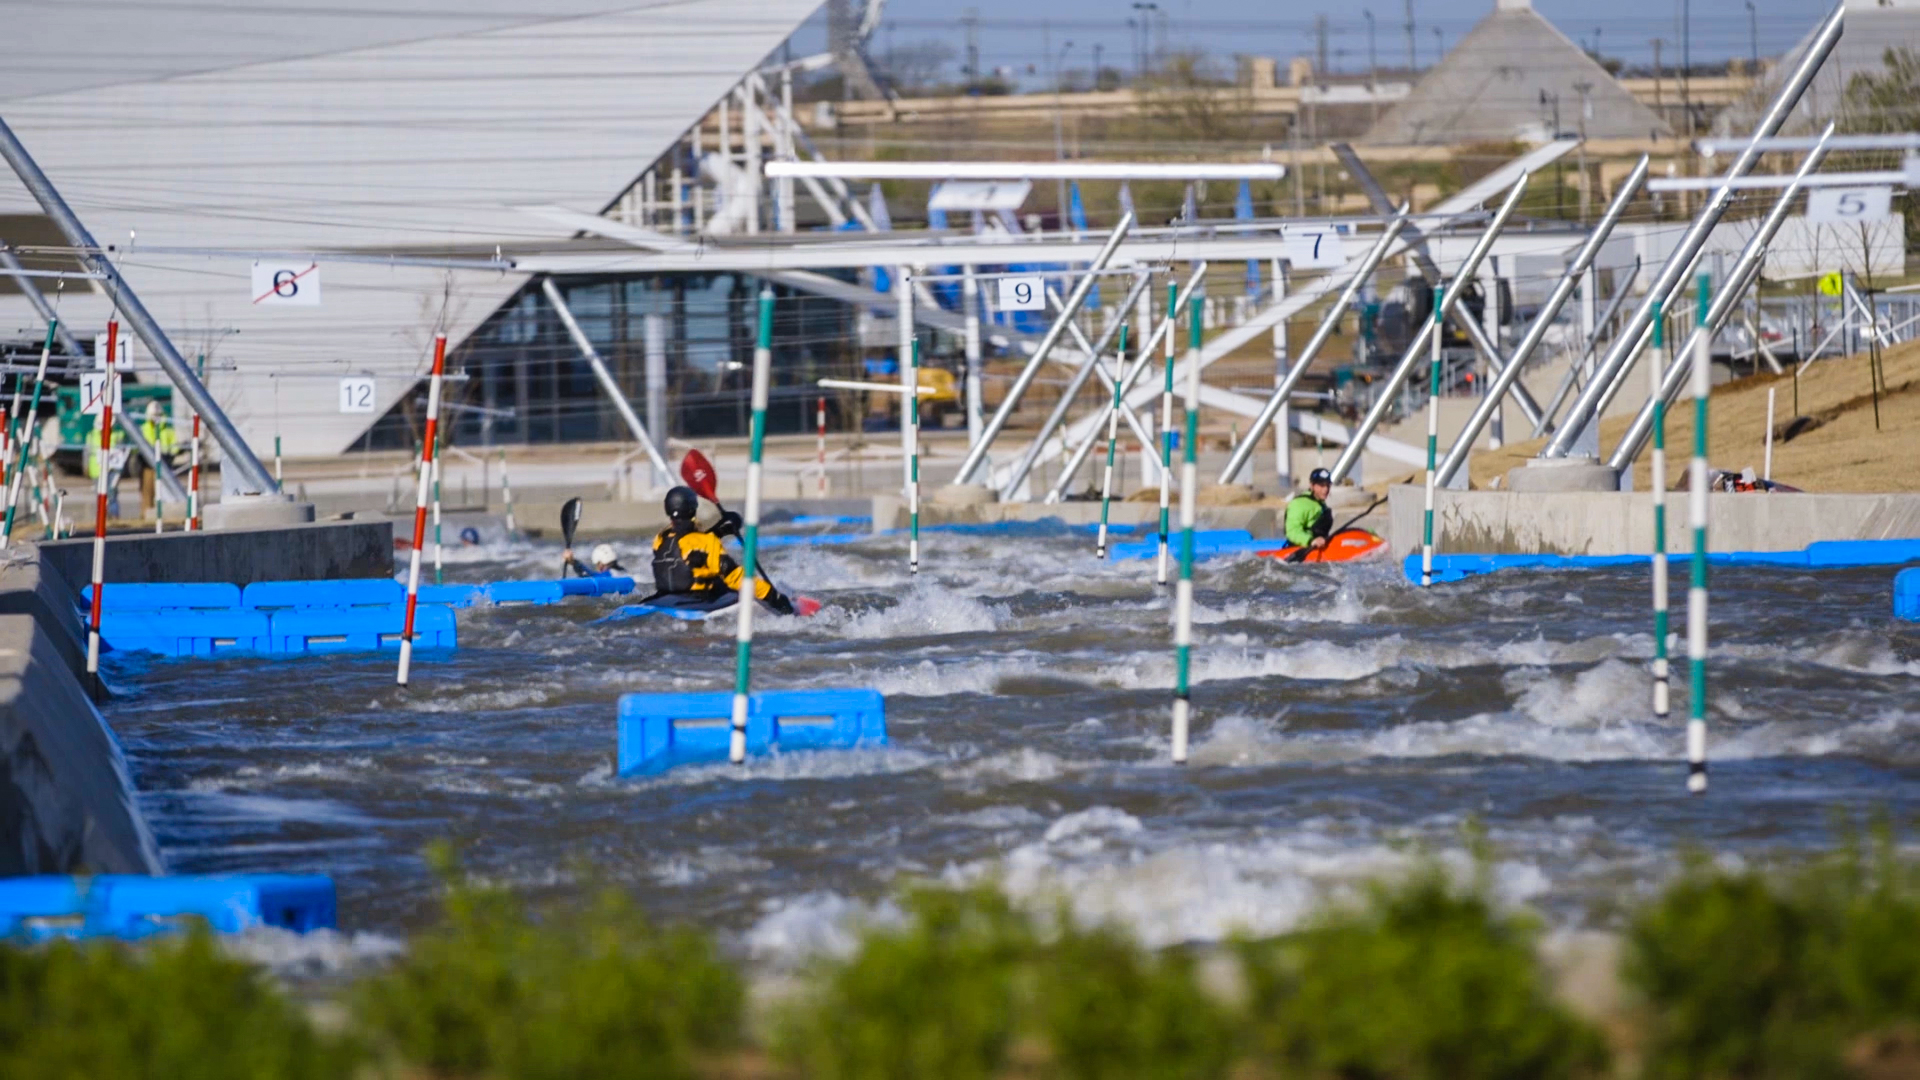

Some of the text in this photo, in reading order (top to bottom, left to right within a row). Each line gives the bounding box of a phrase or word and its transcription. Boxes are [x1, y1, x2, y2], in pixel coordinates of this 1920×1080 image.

[1837, 193, 1866, 216] 5
[1302, 233, 1323, 259] 7
[273, 270, 298, 297] 6
[1015, 282, 1032, 305] 9
[344, 384, 371, 407] 12
